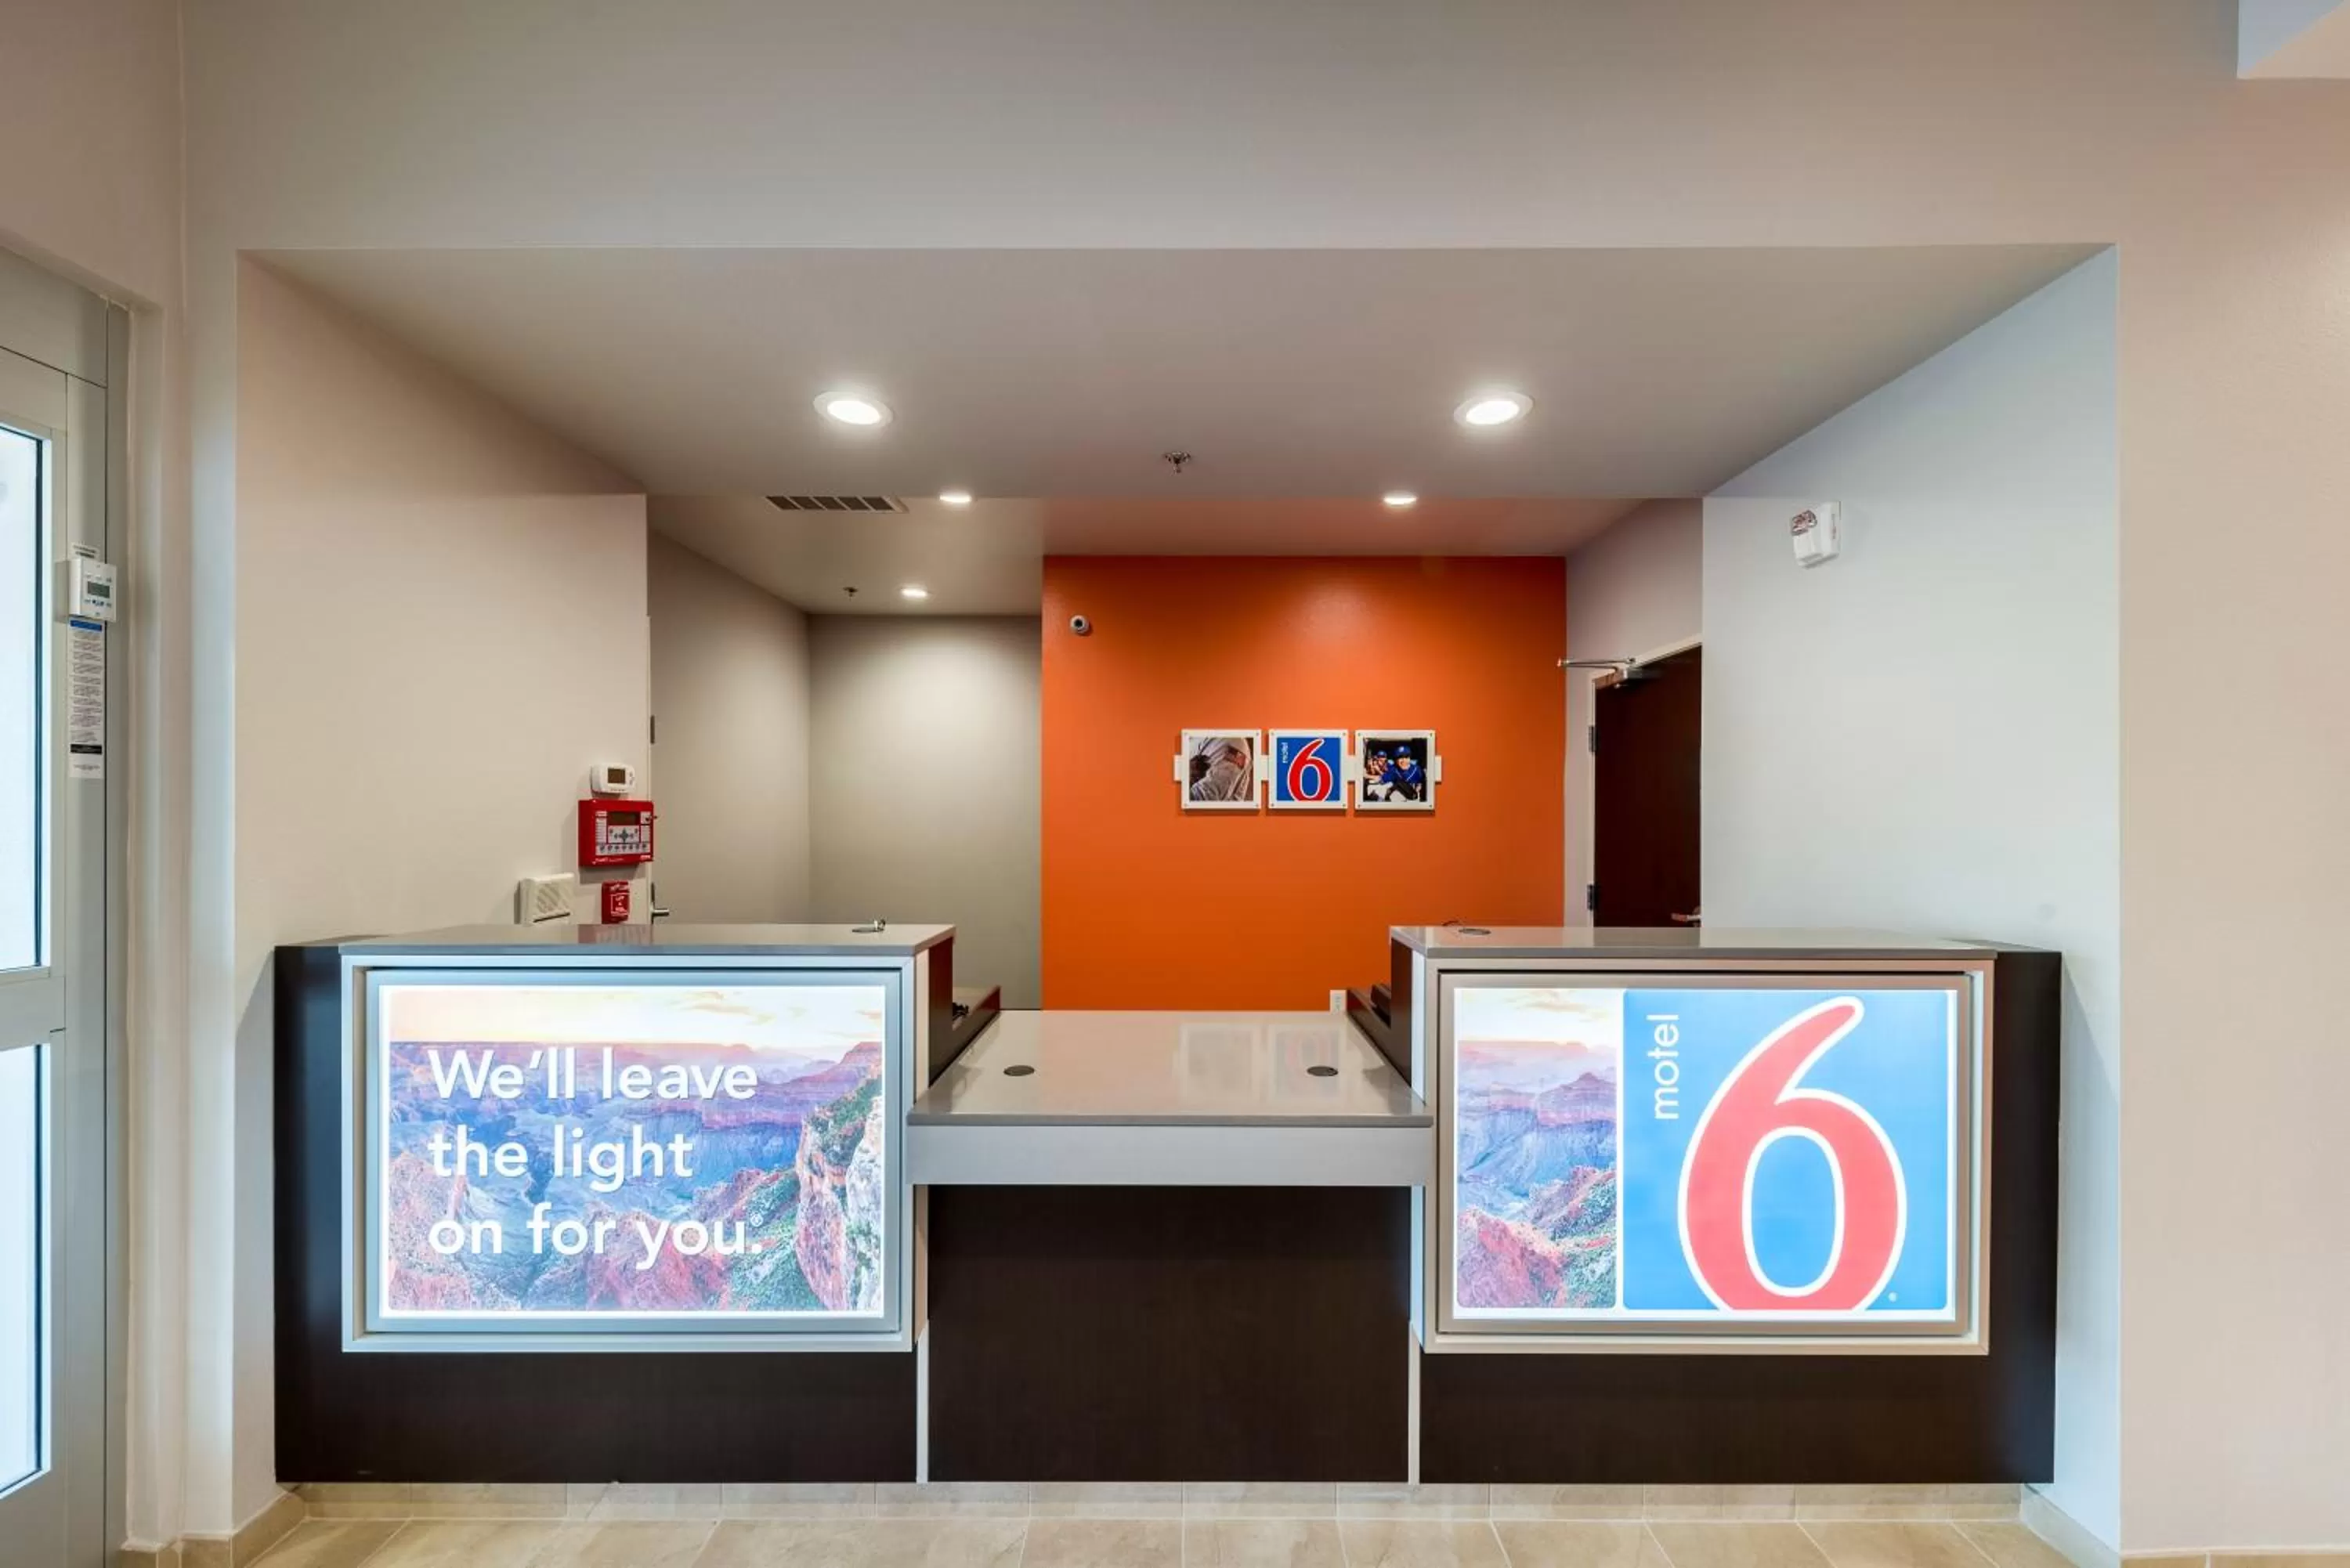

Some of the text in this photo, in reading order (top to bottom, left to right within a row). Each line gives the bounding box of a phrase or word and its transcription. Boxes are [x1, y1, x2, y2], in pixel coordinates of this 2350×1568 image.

[1287, 739, 1333, 801] 6
[427, 1046, 758, 1100] We'll leave
[1647, 1013, 1680, 1121] motel
[427, 1124, 694, 1193] the light
[1677, 995, 1907, 1311] 6
[428, 1217, 502, 1255] on
[526, 1201, 616, 1255] for
